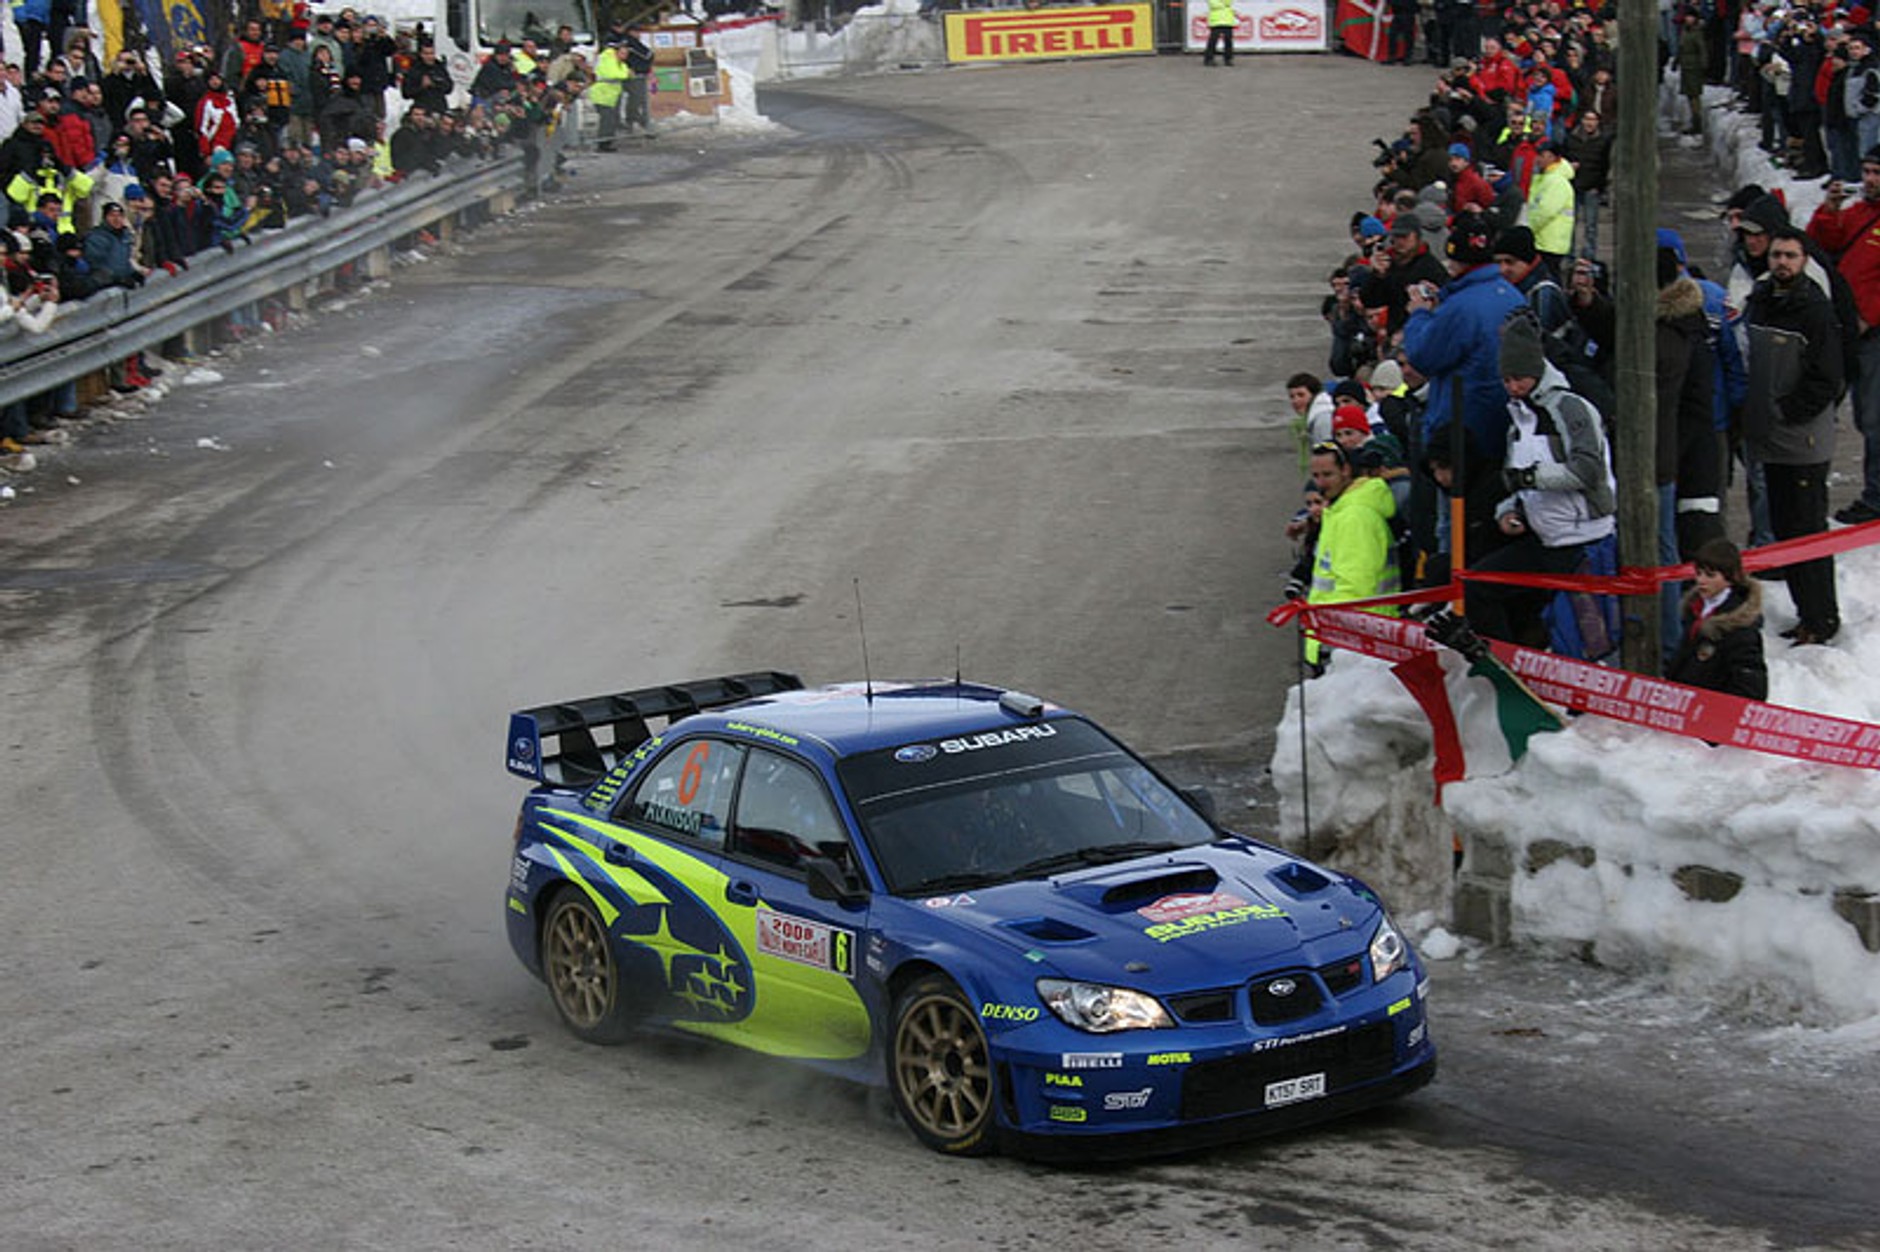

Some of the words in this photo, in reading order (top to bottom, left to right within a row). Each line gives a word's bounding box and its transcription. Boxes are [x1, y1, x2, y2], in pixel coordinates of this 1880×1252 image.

[965, 10, 1134, 55] PIRELLI
[1511, 649, 1626, 695] STATIONNEMENT
[1626, 677, 1695, 712] INTERDIT
[940, 723, 1057, 754] SUBARU
[678, 740, 710, 805] 6
[773, 918, 814, 940] 2008
[1144, 903, 1280, 939] SUBARU
[836, 931, 848, 971] 6
[981, 1003, 1039, 1021] DENSO
[1253, 1038, 1279, 1052] STI
[1062, 1052, 1124, 1068] PIRELLI
[1147, 1052, 1192, 1066] MOTUL
[1045, 1073, 1083, 1087] PIAA
